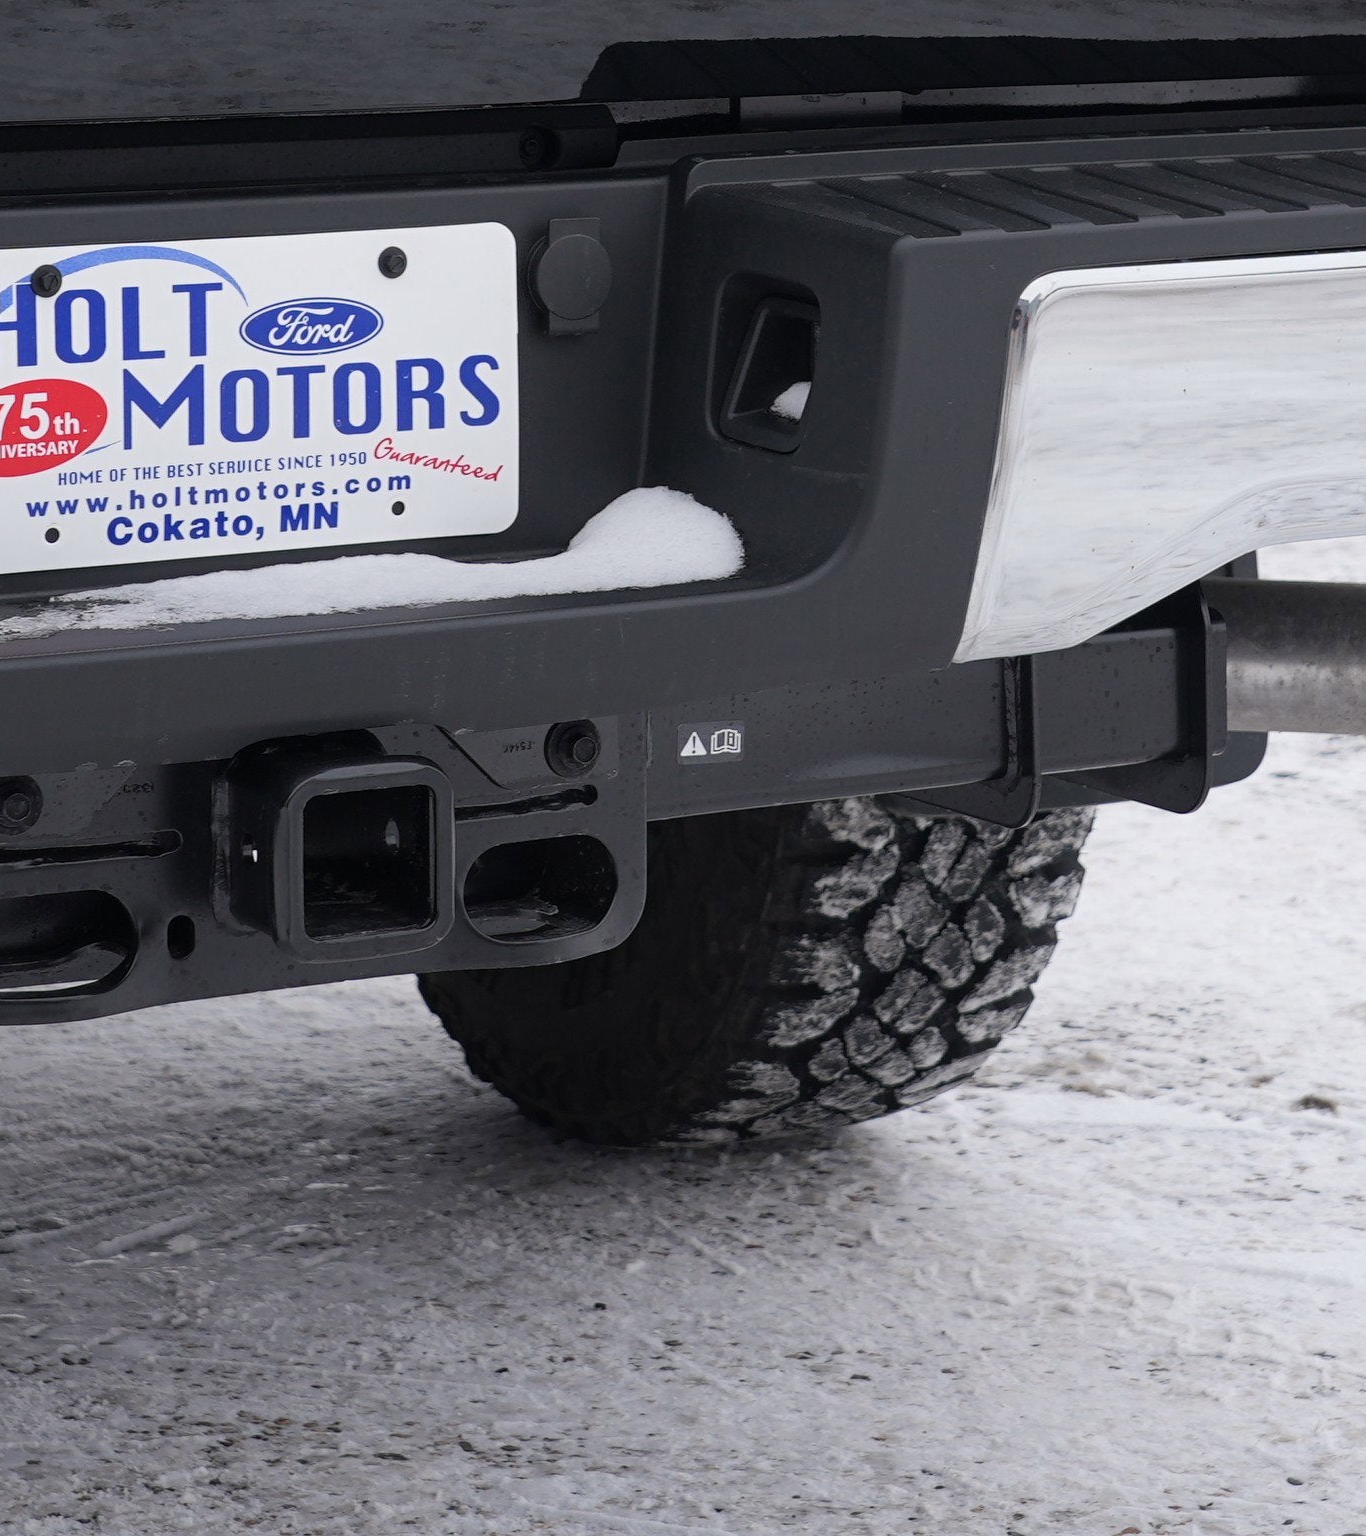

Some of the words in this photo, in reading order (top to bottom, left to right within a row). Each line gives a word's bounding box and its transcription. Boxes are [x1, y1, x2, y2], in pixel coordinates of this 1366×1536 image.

[268, 306, 355, 347] Ford
[123, 353, 500, 450] MOTORS
[57, 470, 103, 486] HOME
[109, 467, 128, 482] OF
[133, 466, 162, 480] THE
[166, 463, 203, 479] BEST
[208, 458, 272, 476] SERVICE
[278, 455, 323, 470] SINCE
[330, 451, 368, 466] 1950
[373, 437, 503, 482] Guaranteed
[26, 473, 413, 518] www.holtmotors.com
[107, 511, 265, 546] Cokato,
[280, 501, 339, 532] MN
